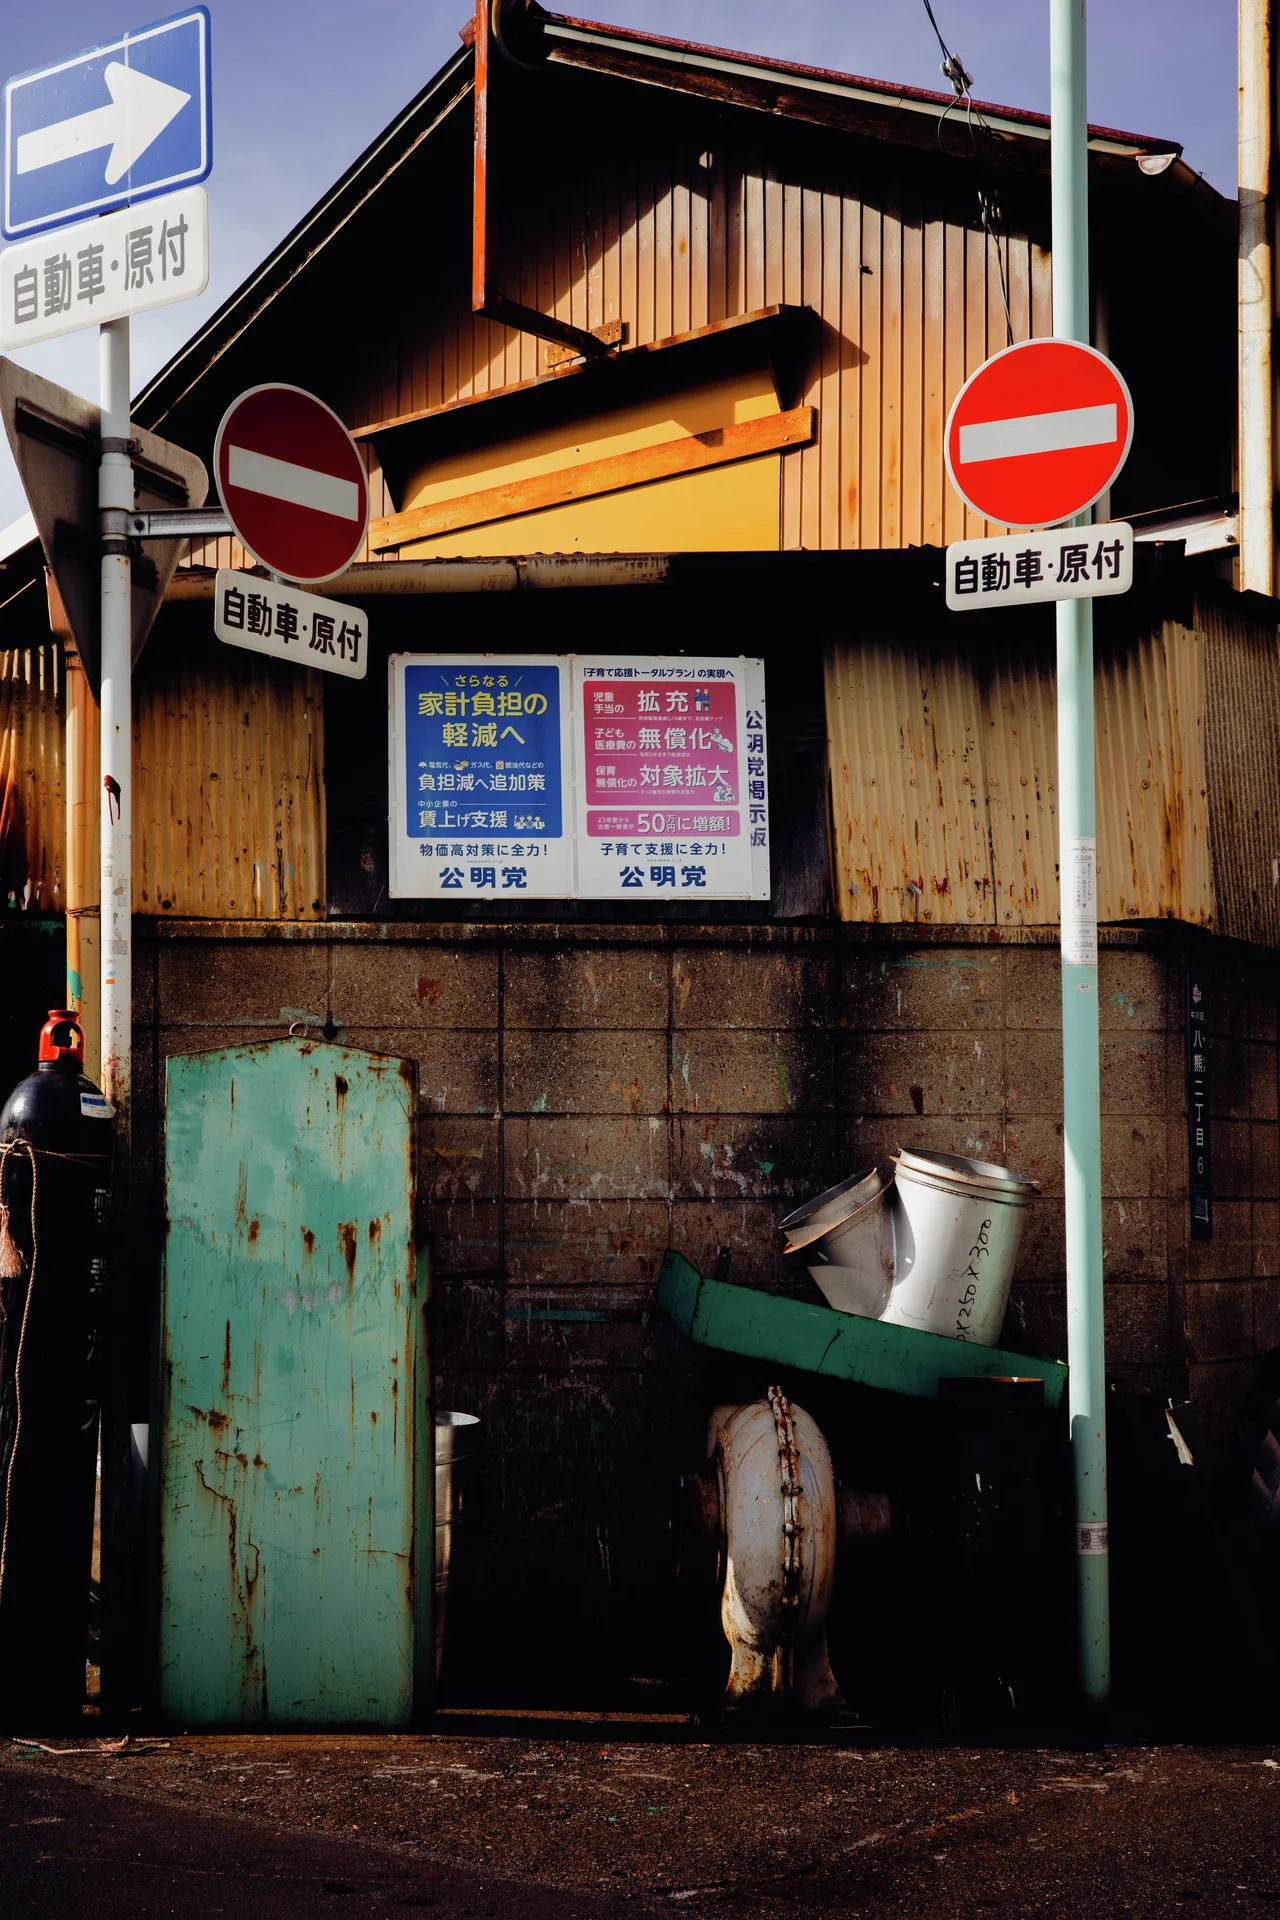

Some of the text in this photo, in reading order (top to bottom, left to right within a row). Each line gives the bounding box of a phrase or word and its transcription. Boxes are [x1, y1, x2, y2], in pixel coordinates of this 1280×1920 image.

[14, 213, 188, 324] 自動車・原付
[955, 539, 1124, 594] 自動車・原付
[223, 587, 362, 662] 自動車・原付
[454, 674, 509, 687] さらなる
[418, 691, 548, 717] 家計負担の
[593, 692, 615, 702] 児童
[637, 689, 689, 714] 拡充
[593, 703, 625, 714] 手当の
[442, 721, 526, 748] 軽減へ
[594, 728, 625, 738] 子ども
[638, 727, 712, 751] 無償化
[594, 740, 636, 751] 医療費の
[595, 765, 616, 776] 保育
[639, 764, 729, 788] 対象拡大
[418, 773, 546, 792] 負担減へ追加策
[595, 778, 637, 788] 無償化の
[417, 800, 458, 808] 中小企業の
[418, 810, 508, 829] 賃上げ支援
[439, 866, 527, 889] 公明党
[619, 865, 706, 888] 公明党
